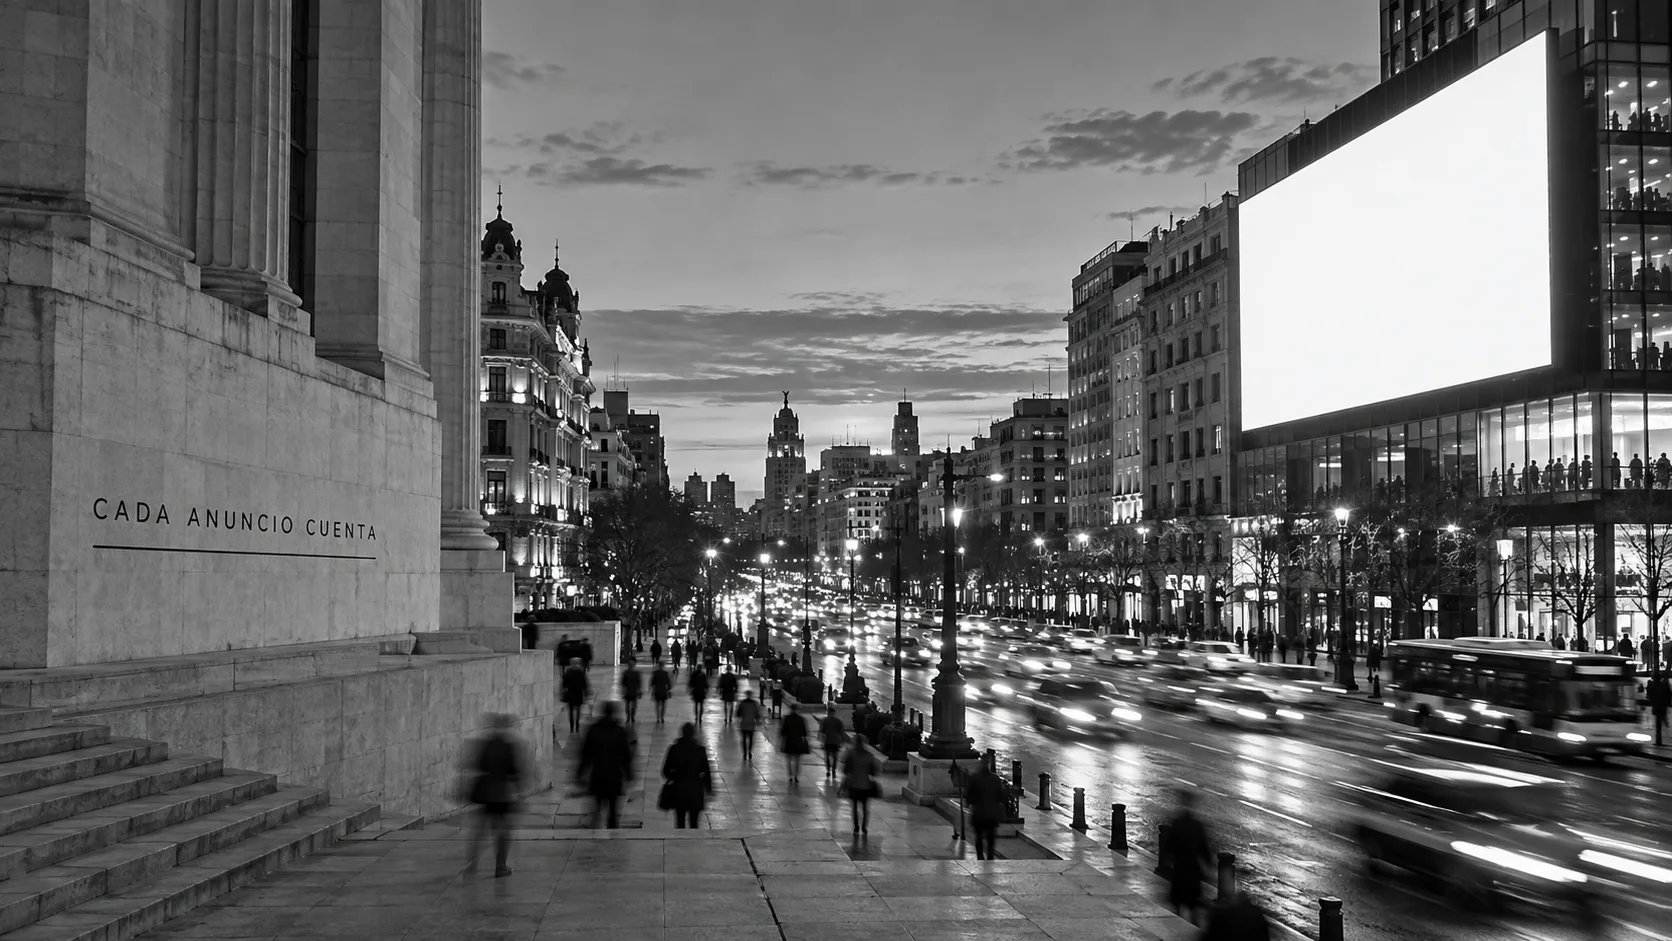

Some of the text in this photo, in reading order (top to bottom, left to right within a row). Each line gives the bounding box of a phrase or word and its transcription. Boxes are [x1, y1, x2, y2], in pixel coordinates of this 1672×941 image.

[93, 497, 377, 541] CADA ANUNCIO CUENTA
